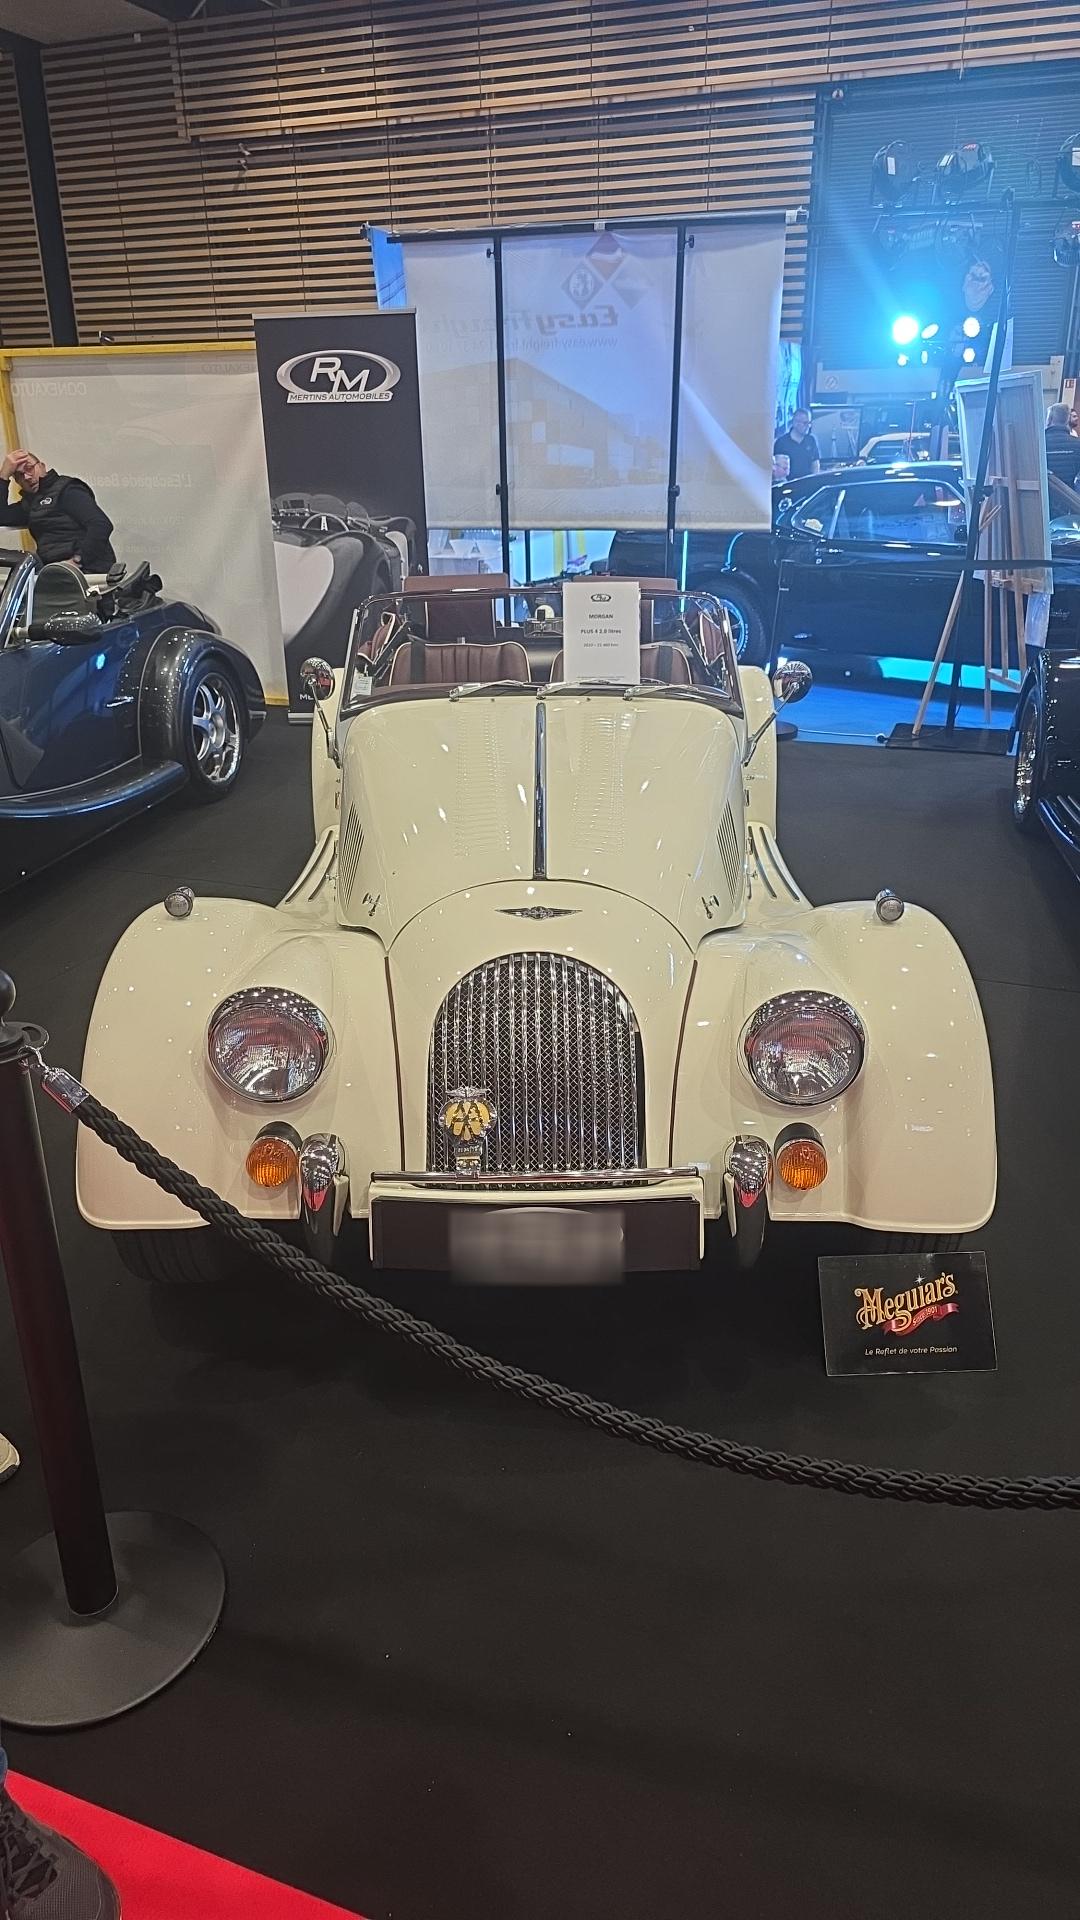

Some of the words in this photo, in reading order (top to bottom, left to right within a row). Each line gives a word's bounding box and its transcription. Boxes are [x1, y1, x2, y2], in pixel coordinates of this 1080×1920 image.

[310, 357, 370, 392] RM
[329, 392, 390, 400] AUTOMOBILES
[854, 1272, 957, 1332] Meguiar's
[864, 1348, 874, 1356] Le
[875, 1347, 897, 1357] Reflet
[898, 1347, 908, 1355] de
[929, 1345, 958, 1354] Passion
